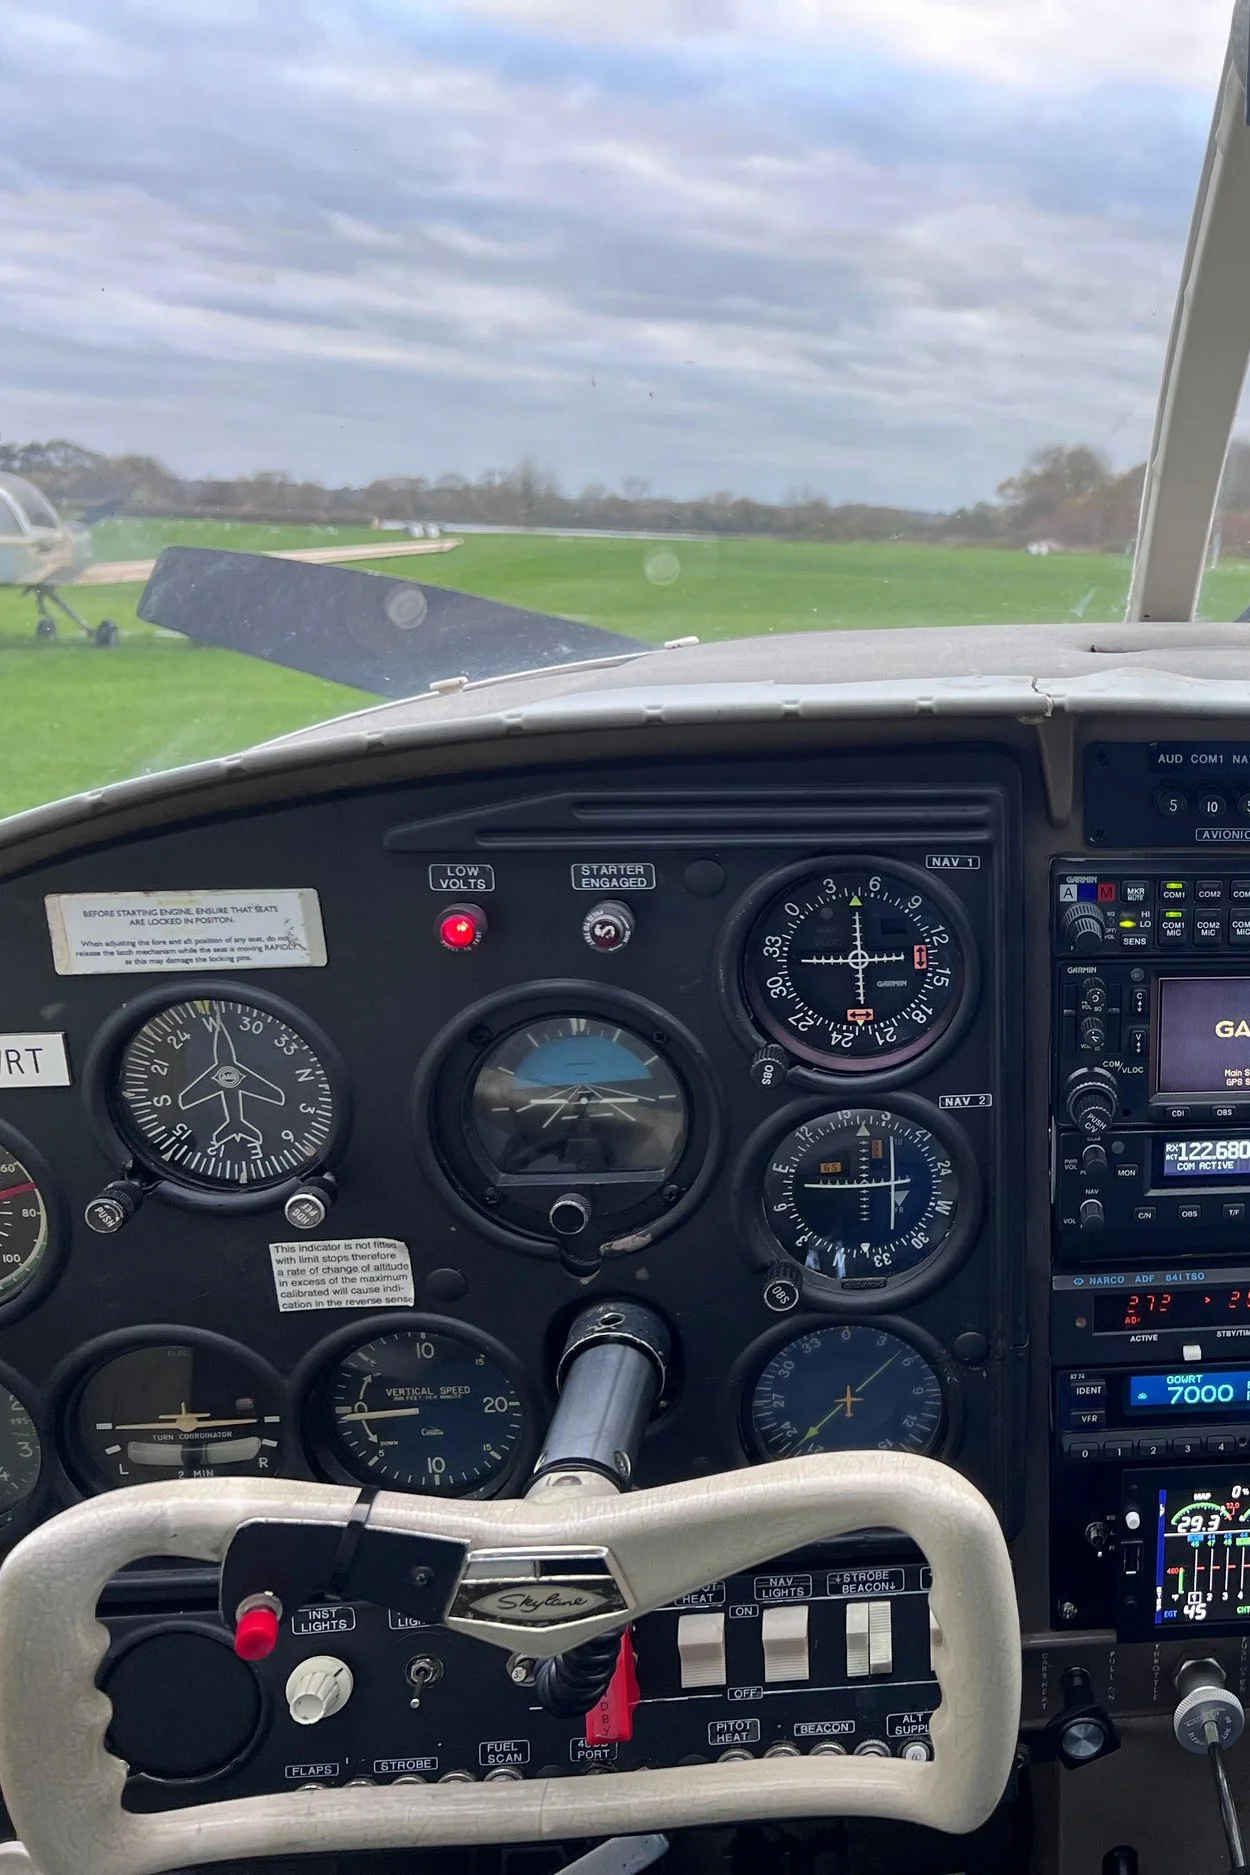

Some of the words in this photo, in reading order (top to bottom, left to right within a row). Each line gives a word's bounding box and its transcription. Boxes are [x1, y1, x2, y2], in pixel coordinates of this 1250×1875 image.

[1158, 754, 1183, 765] AUD
[1191, 755, 1223, 764] COM1
[932, 857, 958, 867] NAV
[968, 858, 973, 867] 1
[447, 867, 479, 876] LOW
[581, 866, 644, 876] STARTER
[440, 879, 486, 889] VOLTS
[582, 878, 646, 888] ENGAGED
[1225, 1069, 1242, 1077] Main
[945, 1098, 970, 1106] NAV
[979, 1096, 985, 1104] 2
[1178, 1141, 1250, 1160] 122.680
[1200, 1161, 1234, 1169] ACTIVE
[275, 1245, 296, 1253] This
[300, 1243, 341, 1252] indicator
[374, 1241, 396, 1249] fitted
[276, 1256, 296, 1264] with
[300, 1255, 318, 1263] limit
[322, 1254, 349, 1263] stops
[352, 1252, 396, 1260] therefore
[322, 1265, 358, 1274] change
[362, 1264, 370, 1272] of
[374, 1263, 409, 1271] altitude
[360, 1274, 407, 1282] maximum
[1089, 1276, 1124, 1284] NARCO
[1136, 1275, 1154, 1283] ADF
[1185, 1272, 1204, 1280] TSO
[281, 1289, 329, 1298] calibrated
[383, 1284, 404, 1292] indi-
[282, 1301, 312, 1309] cation
[1130, 1334, 1158, 1342] ACTIVE
[1167, 1375, 1203, 1384] GOWRT
[386, 1386, 435, 1396] VERTICAL
[440, 1385, 471, 1394] SPEED
[1076, 1386, 1101, 1395] IDENT
[1168, 1385, 1233, 1404] 7000
[484, 1398, 508, 1413] 20
[179, 1431, 232, 1440] COORDINATOR
[1178, 1515, 1220, 1532] 29.3
[770, 1577, 793, 1585] NAV
[843, 1572, 889, 1582] STROBE
[763, 1586, 804, 1597] LIGHTS
[842, 1582, 889, 1592] BEACON
[498, 1594, 588, 1612] Skylane
[309, 1610, 336, 1620] INST
[736, 1606, 752, 1616] ON
[301, 1620, 347, 1631] LIGHTS
[735, 1688, 758, 1698] OFF
[716, 1722, 751, 1731] PITOT
[801, 1723, 848, 1733] BEACON
[717, 1732, 748, 1741] HEAT
[487, 1743, 517, 1753] FUEL
[489, 1753, 522, 1763] SCAN
[381, 1760, 431, 1771] STROBE
[292, 1766, 332, 1776] FLAPS
